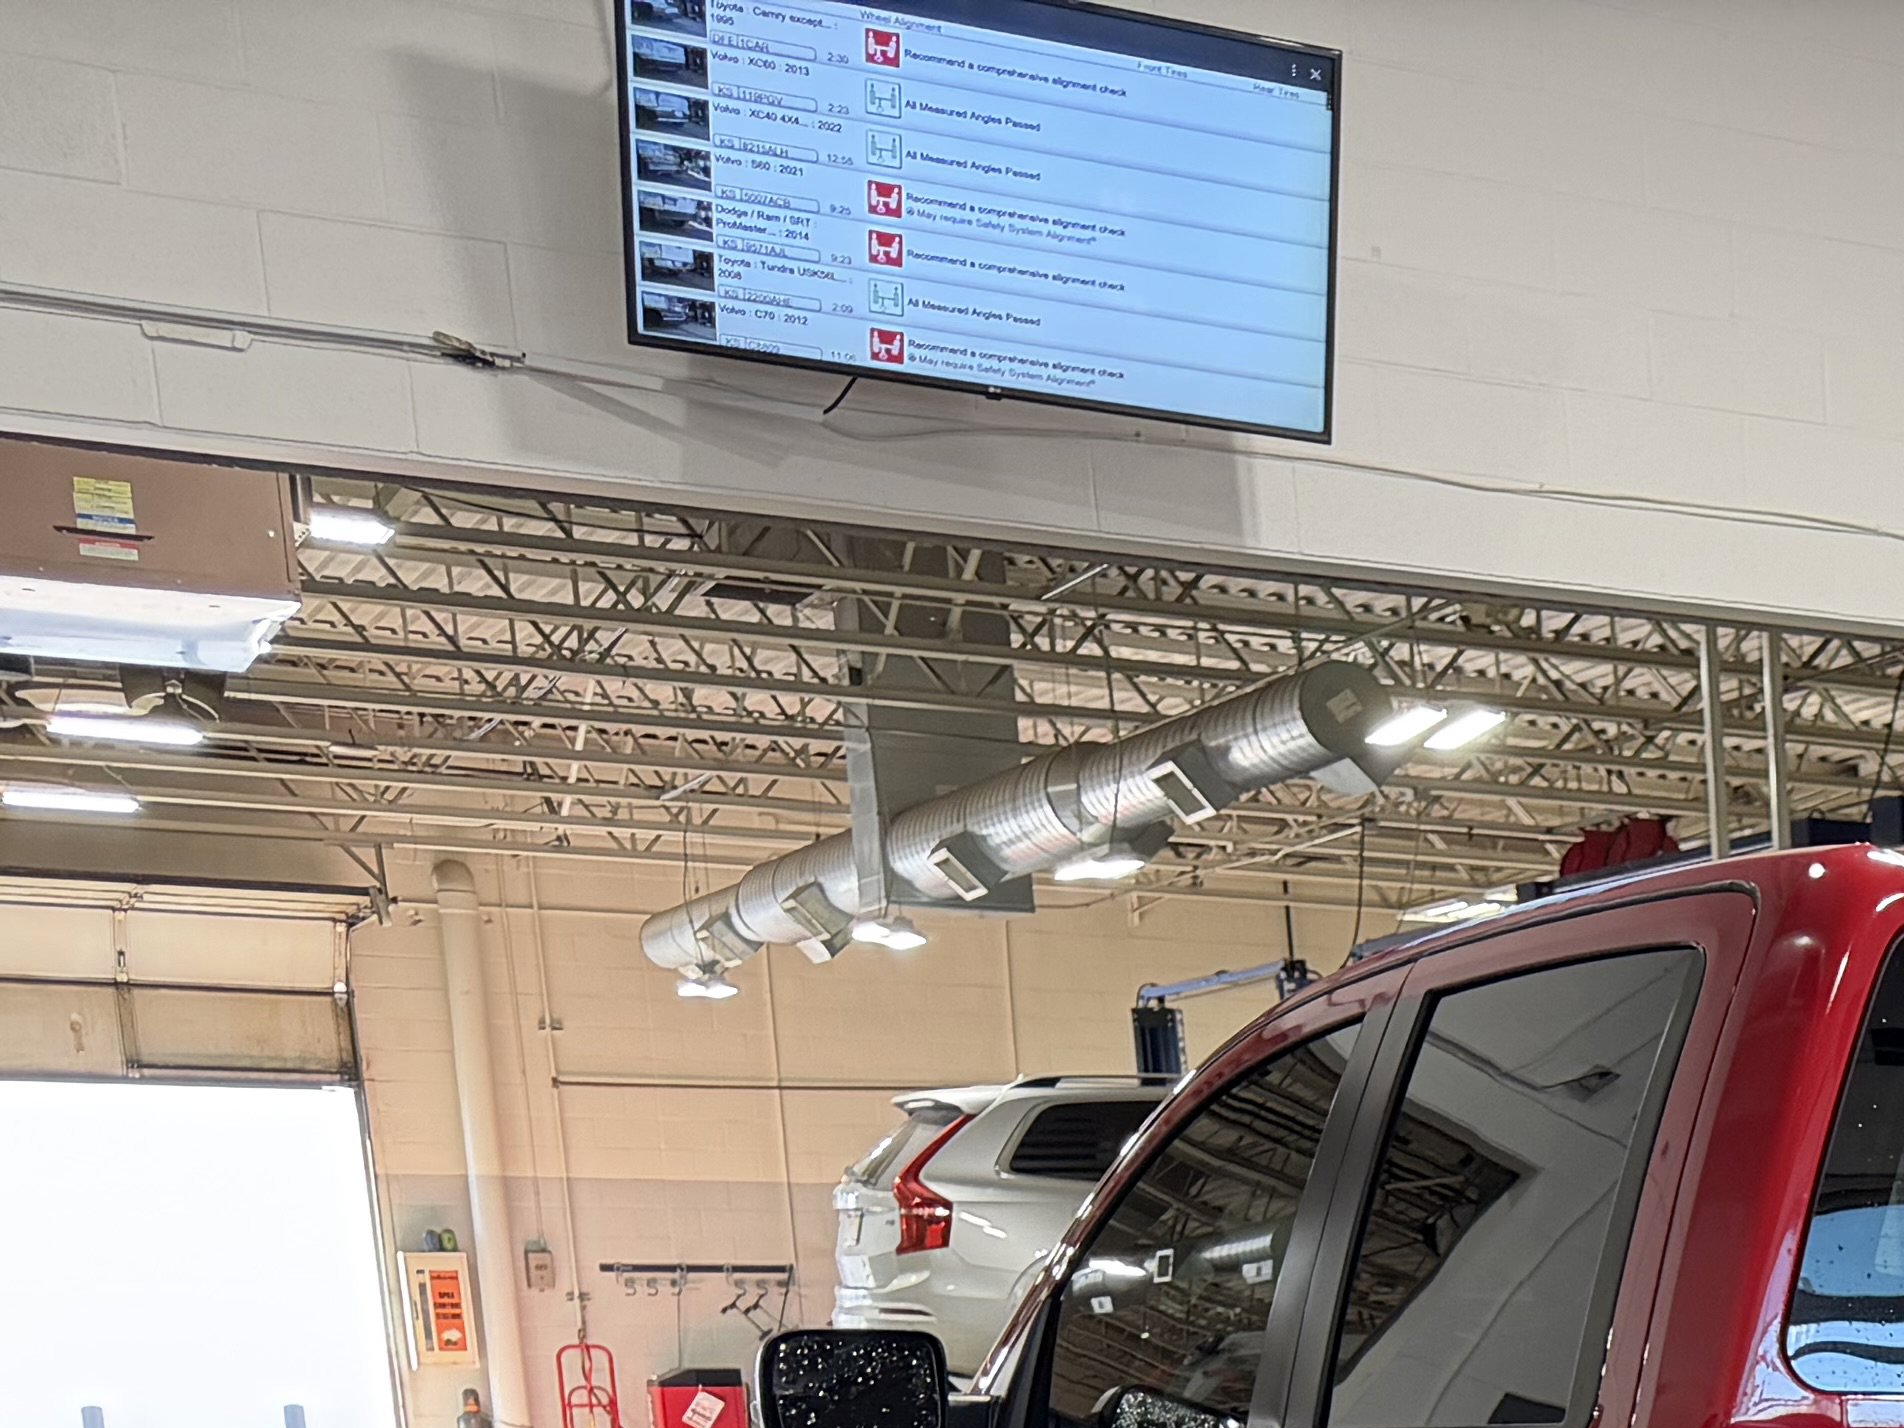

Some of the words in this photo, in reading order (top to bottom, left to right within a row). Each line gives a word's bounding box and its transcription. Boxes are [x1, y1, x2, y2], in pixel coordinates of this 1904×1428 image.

[752, 7, 786, 23] Camry
[860, 10, 891, 22] Wheel
[893, 16, 942, 33] Alignment
[711, 51, 739, 64] Volvo
[784, 63, 810, 76] 2013
[904, 48, 965, 69] Recommend
[977, 64, 1050, 84] comprehensive
[1051, 76, 1097, 93] alignment
[1099, 84, 1127, 97] check
[712, 101, 741, 116] Volvo
[904, 99, 917, 110] All
[919, 102, 967, 119] Measured
[969, 111, 1002, 125] Angles
[1005, 116, 1041, 132] Passed
[714, 153, 742, 167] Volvo
[905, 150, 917, 160] All
[920, 152, 968, 169] Measured
[970, 161, 1002, 175] Angles
[1005, 166, 1041, 181] Passed
[715, 204, 749, 220] Dodge
[757, 210, 781, 223] Ram
[906, 192, 967, 212] Recommend
[977, 206, 1050, 225] comprehensive
[1051, 218, 1097, 233] alignment
[1098, 225, 1126, 236] check
[917, 209, 938, 222] May
[940, 214, 973, 228] require
[718, 254, 752, 269] Toyota
[759, 260, 795, 275] Tundra
[906, 248, 967, 267] Recommend
[978, 261, 1050, 281] comprehensive
[1051, 272, 1097, 288] alignment
[1098, 280, 1125, 292] check
[718, 303, 746, 317] Volvo
[907, 297, 919, 308] All
[921, 299, 969, 316] Measured
[971, 308, 1003, 322] Angles
[1005, 312, 1041, 327] Passed
[907, 338, 968, 357] Recommend
[978, 351, 1050, 371] comprehensive
[1051, 361, 1097, 376] alignment
[1098, 368, 1125, 380] check
[918, 354, 939, 368] May
[941, 359, 974, 373] require
